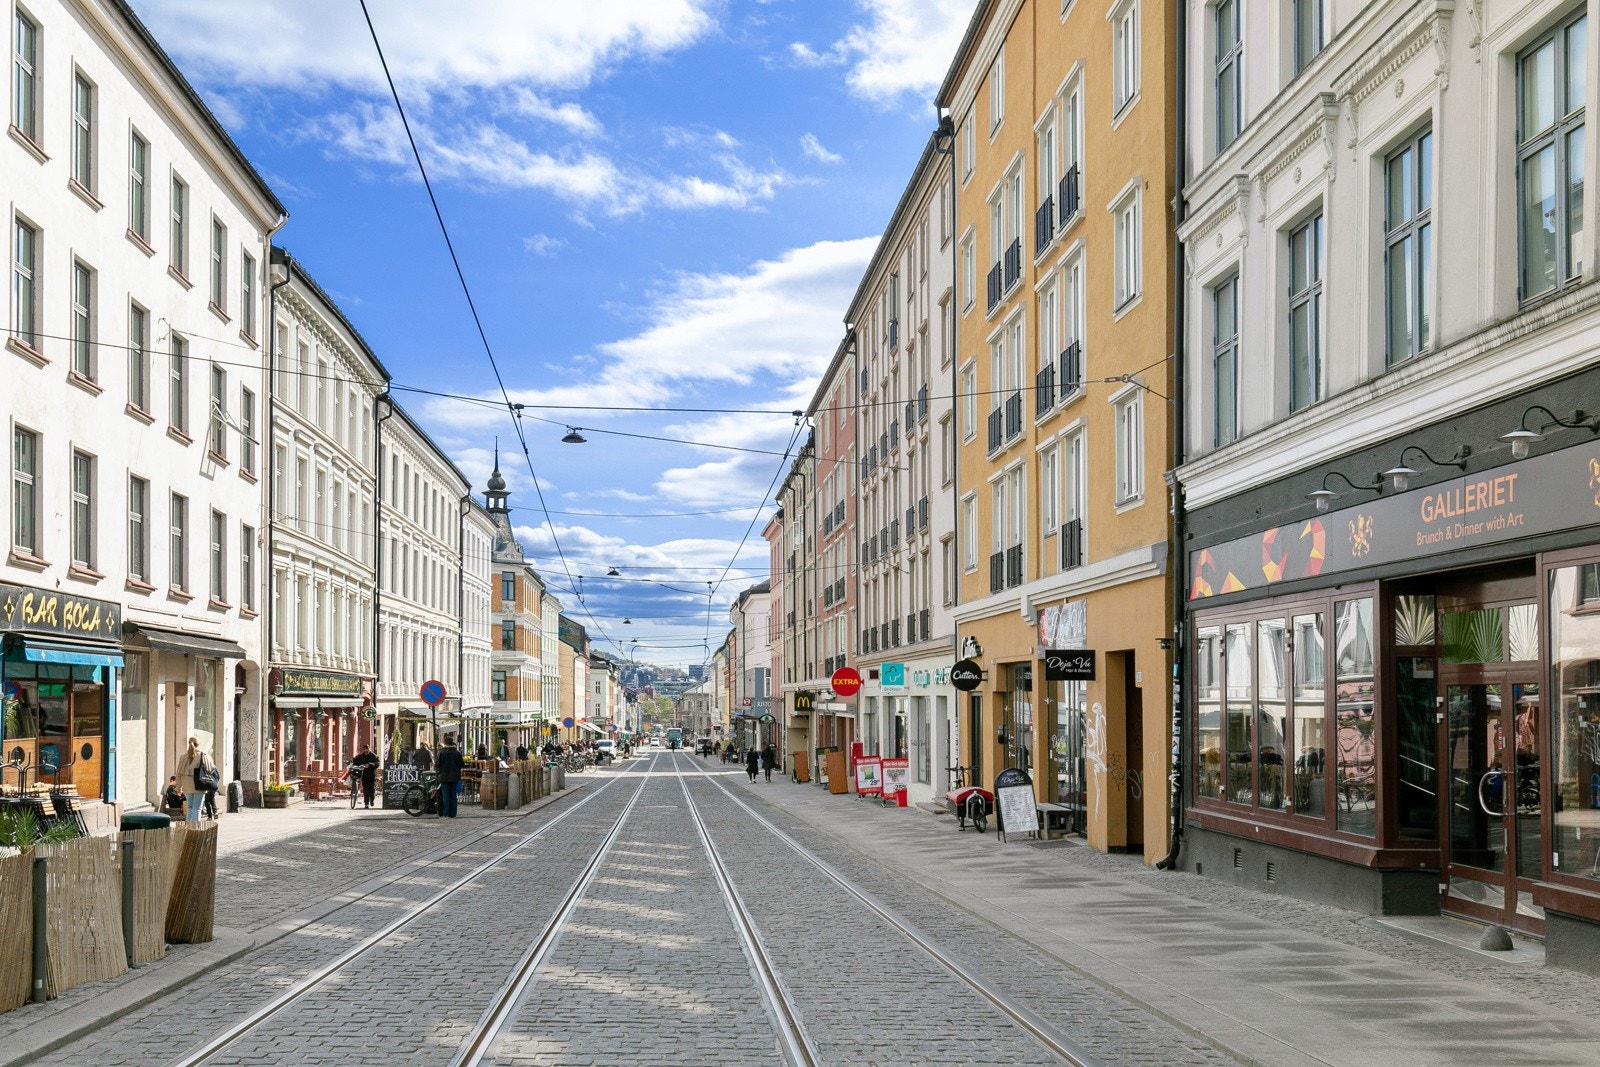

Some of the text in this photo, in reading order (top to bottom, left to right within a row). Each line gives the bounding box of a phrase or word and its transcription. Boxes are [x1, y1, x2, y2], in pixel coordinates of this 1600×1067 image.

[1421, 473, 1518, 523] GALLERIET
[1416, 512, 1524, 546] Brunch & Dinner with Art
[22, 592, 100, 631] BAR BOCA
